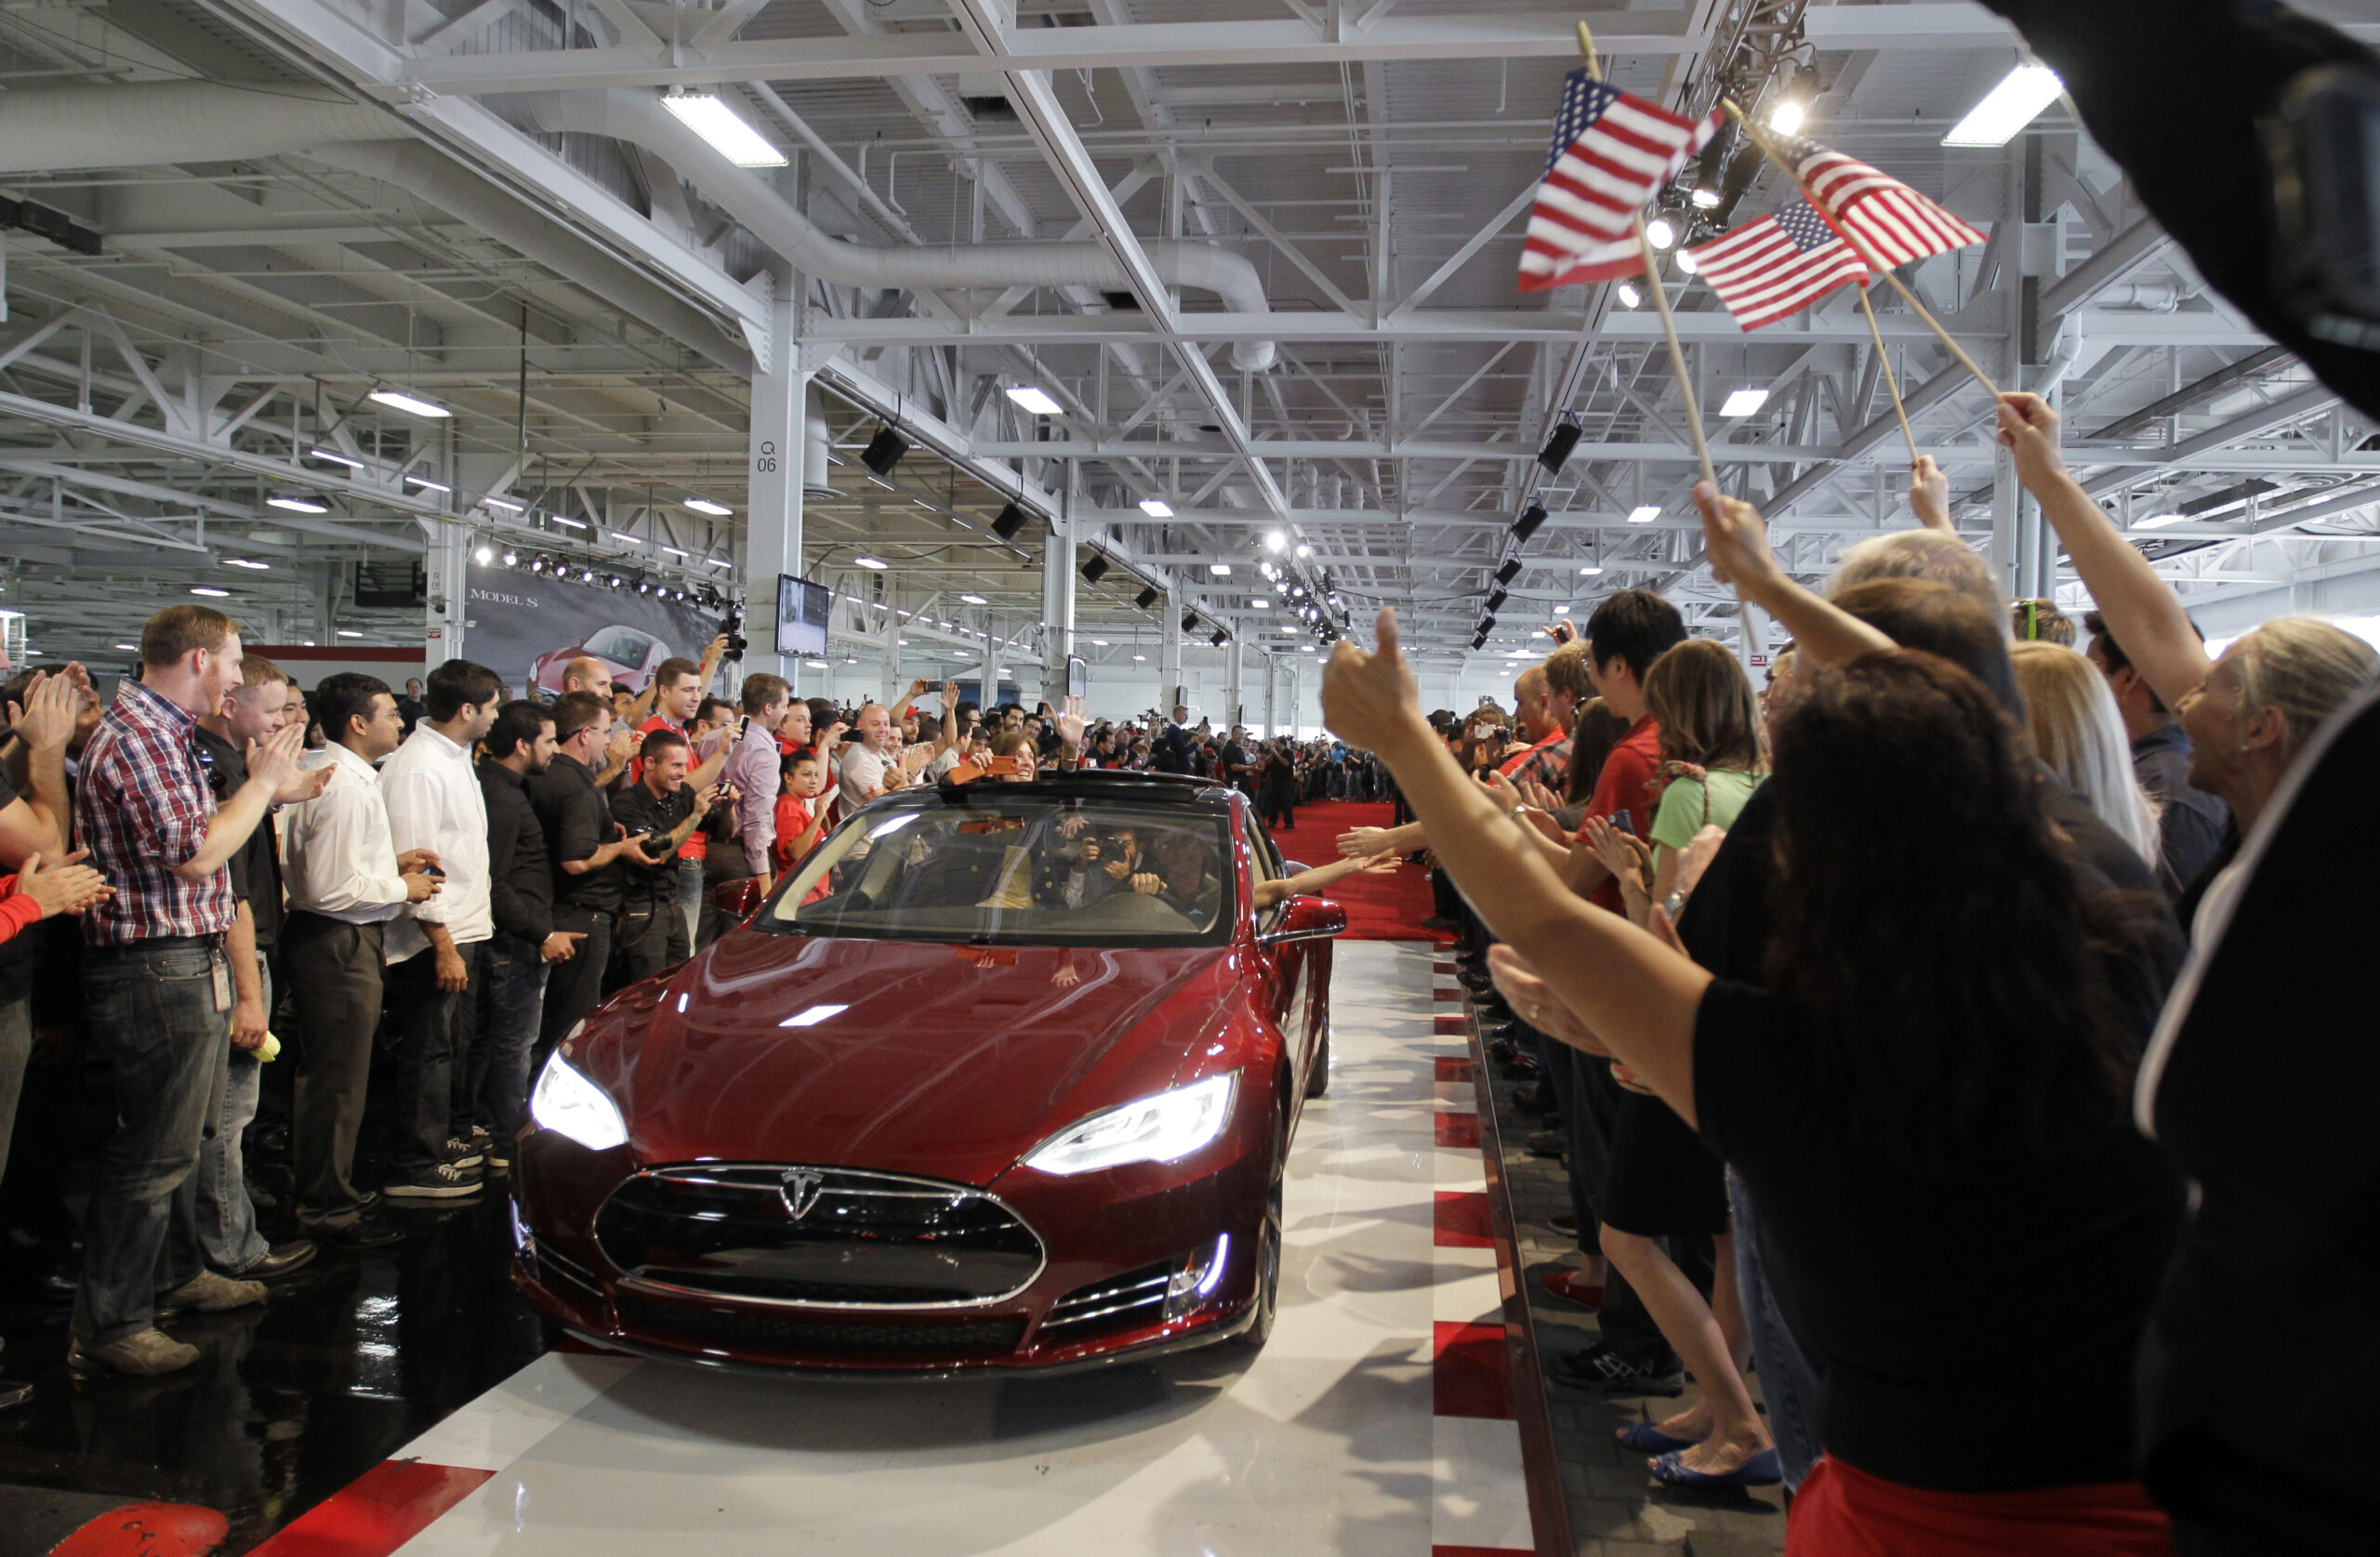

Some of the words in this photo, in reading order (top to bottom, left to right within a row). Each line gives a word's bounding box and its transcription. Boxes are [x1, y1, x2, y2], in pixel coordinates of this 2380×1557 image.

[760, 441, 774, 455] Q
[757, 457, 776, 472] 06
[469, 587, 523, 606] MODEL
[526, 597, 538, 608] S
